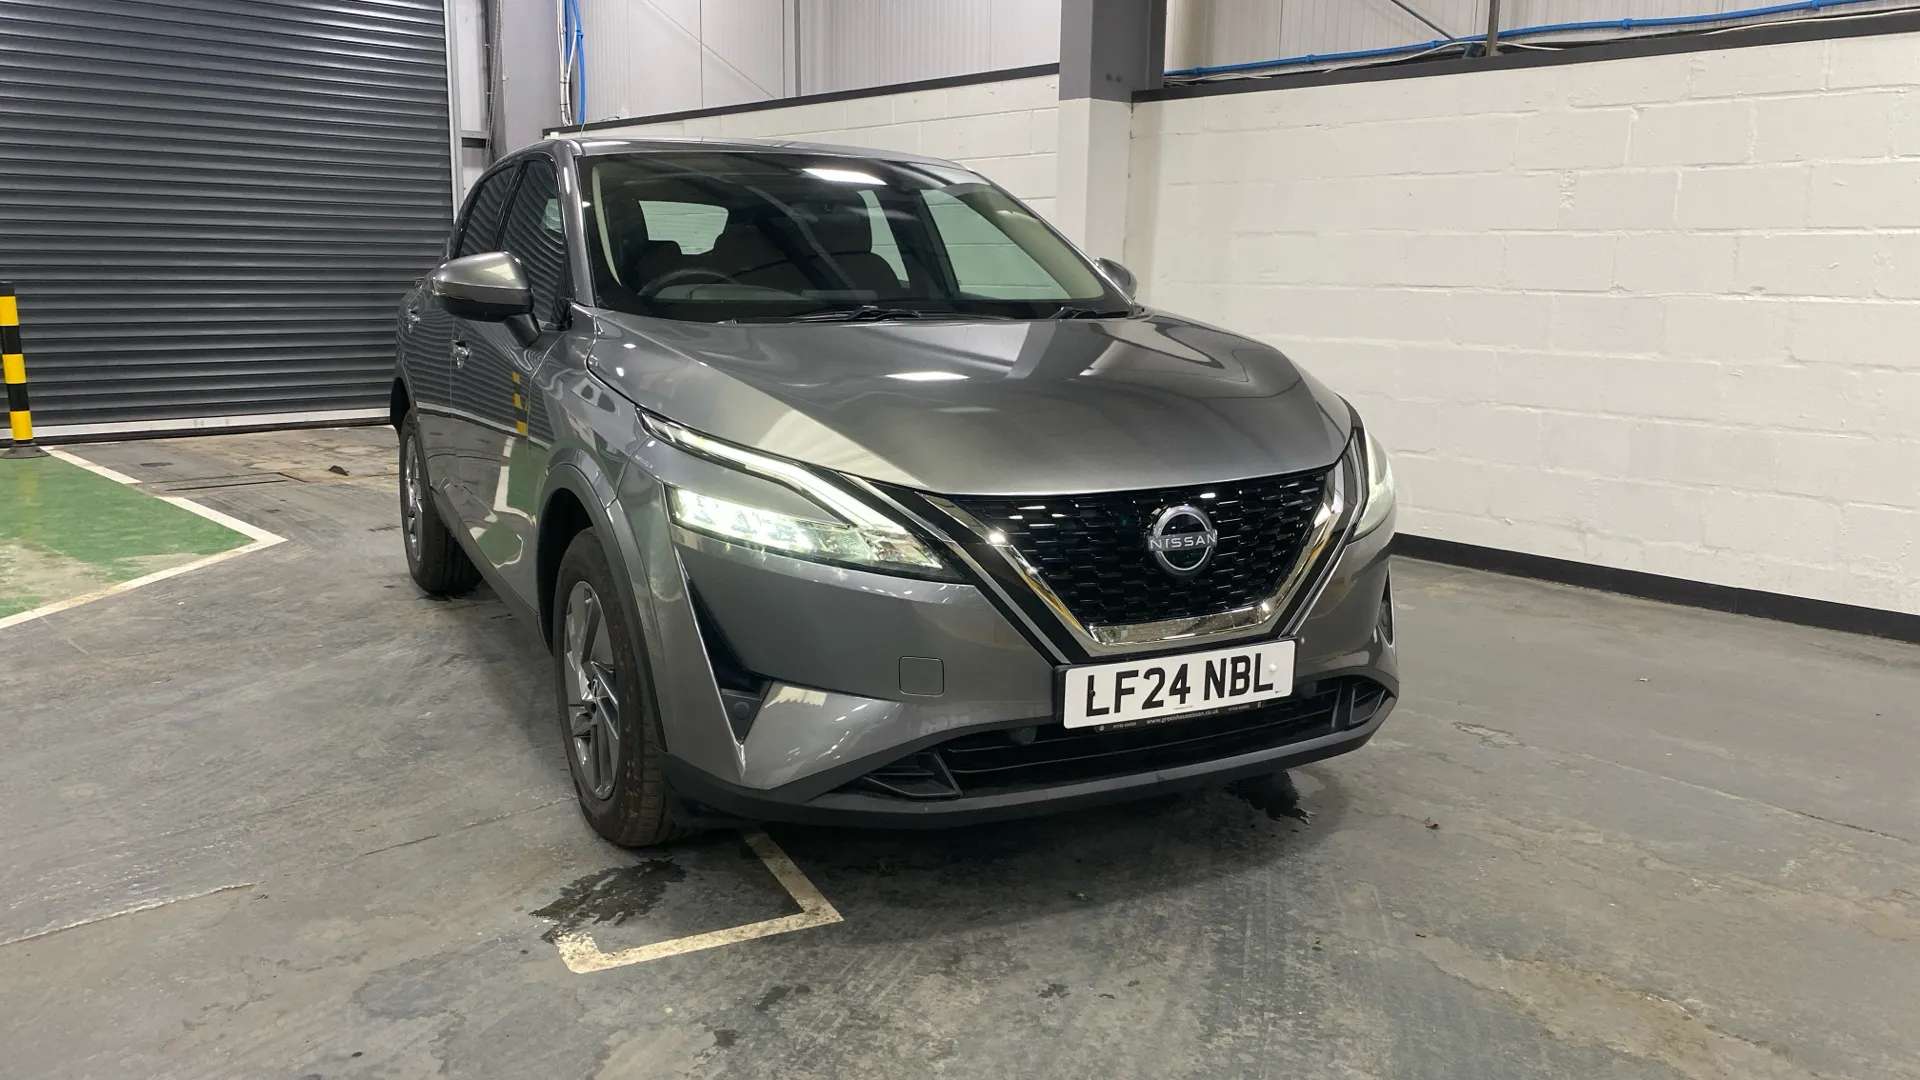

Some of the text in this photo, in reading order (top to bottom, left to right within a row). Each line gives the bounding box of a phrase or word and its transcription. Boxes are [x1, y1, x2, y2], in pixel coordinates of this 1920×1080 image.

[1149, 529, 1218, 550] NISSAN
[1086, 652, 1274, 718] LF24 NBL
